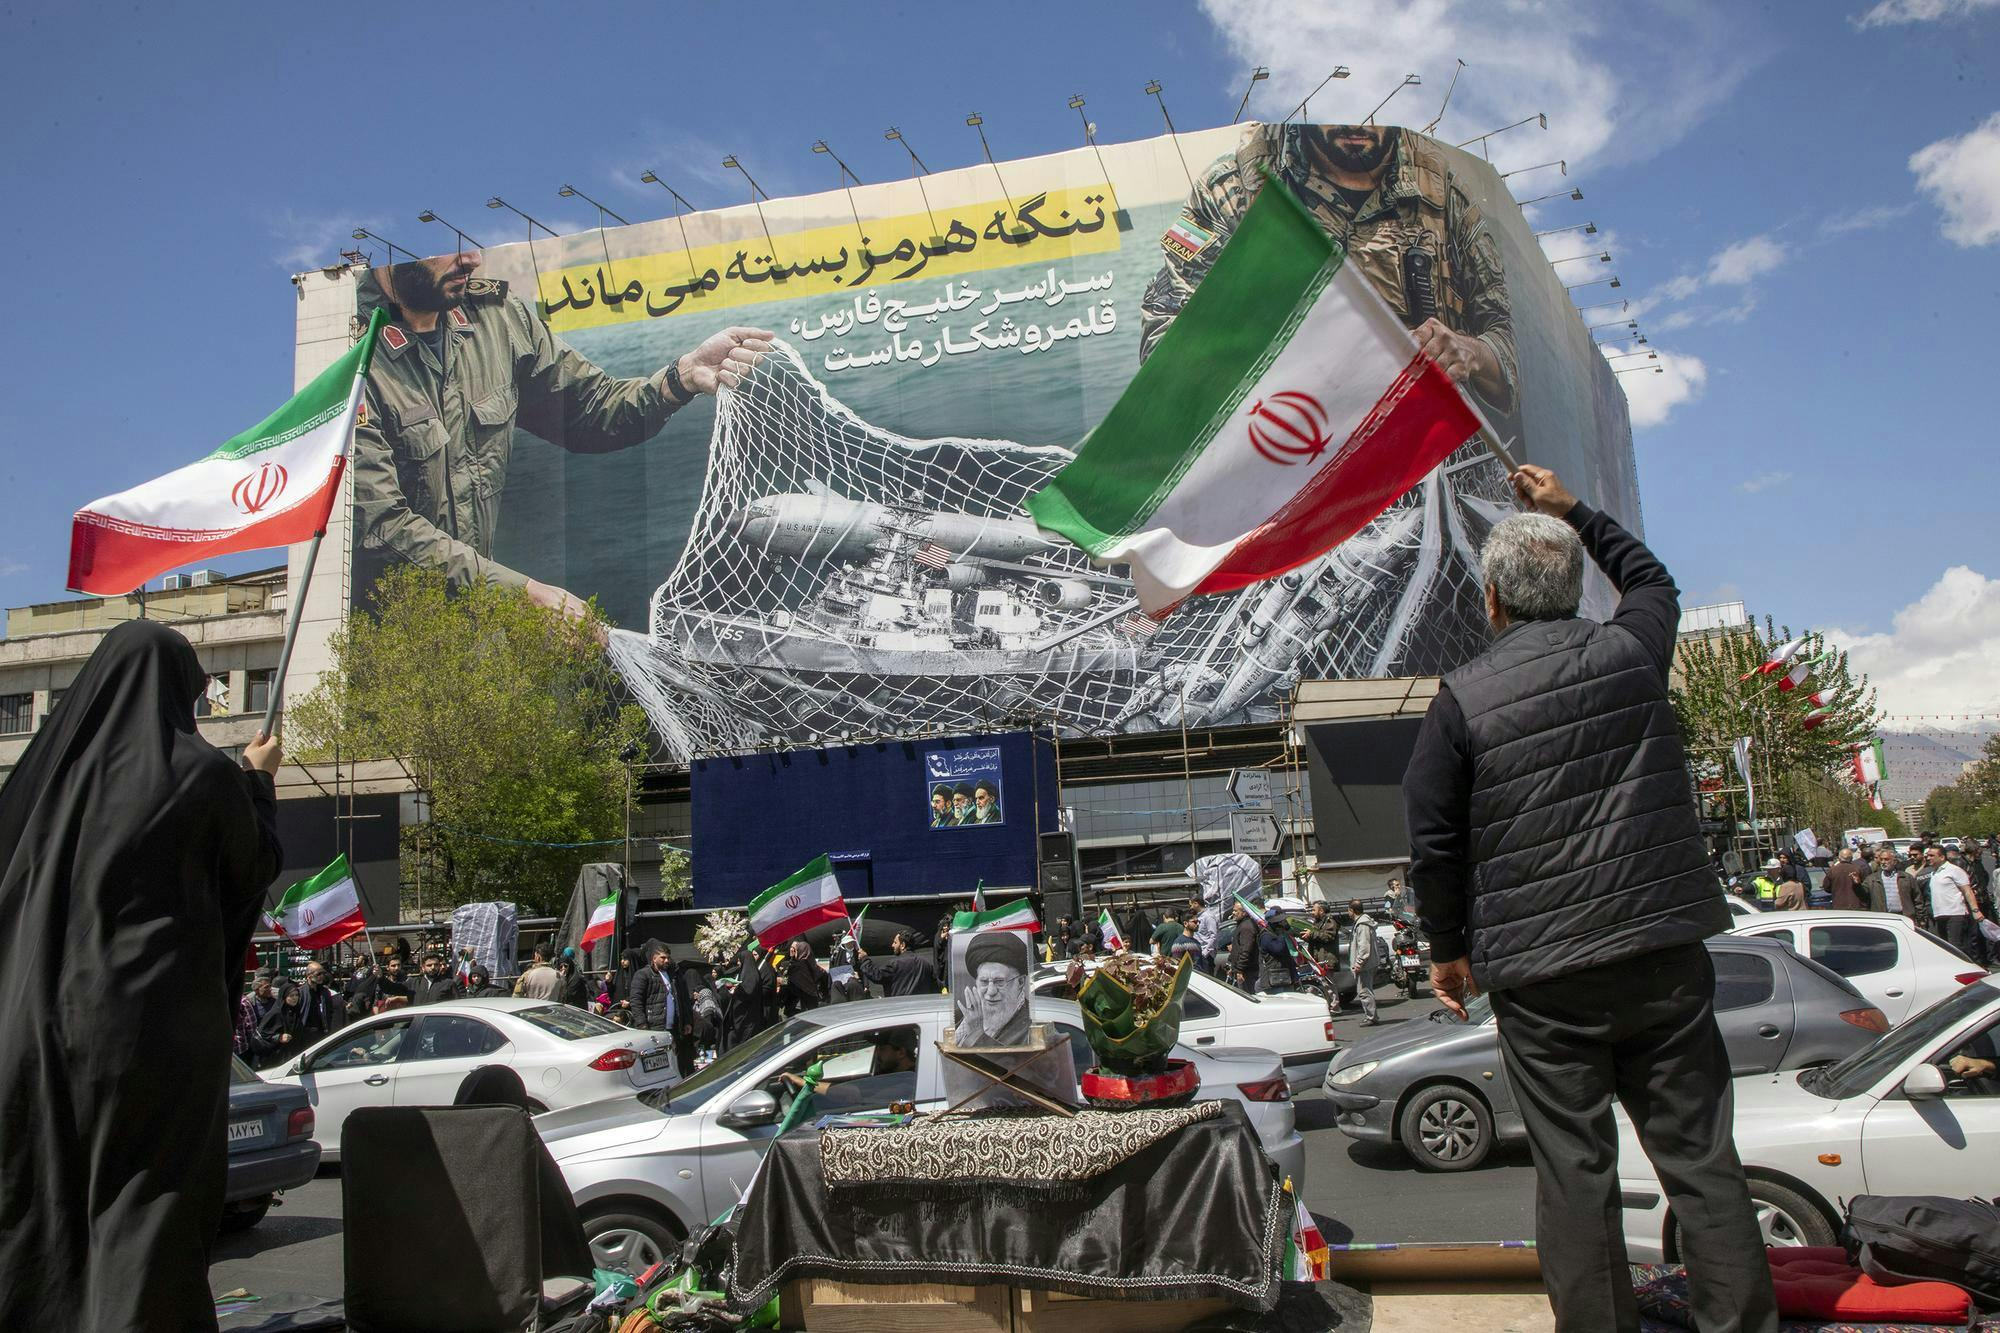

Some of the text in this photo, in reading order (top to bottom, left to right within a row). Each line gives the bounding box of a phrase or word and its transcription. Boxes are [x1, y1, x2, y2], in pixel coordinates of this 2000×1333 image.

[983, 191, 1105, 245] تنگه
[725, 246, 848, 284] بسته
[846, 219, 977, 287] هرمز
[883, 280, 982, 332] خلیج
[980, 268, 1114, 316] سراسر
[824, 299, 1117, 371] قلمرو شکار ماست
